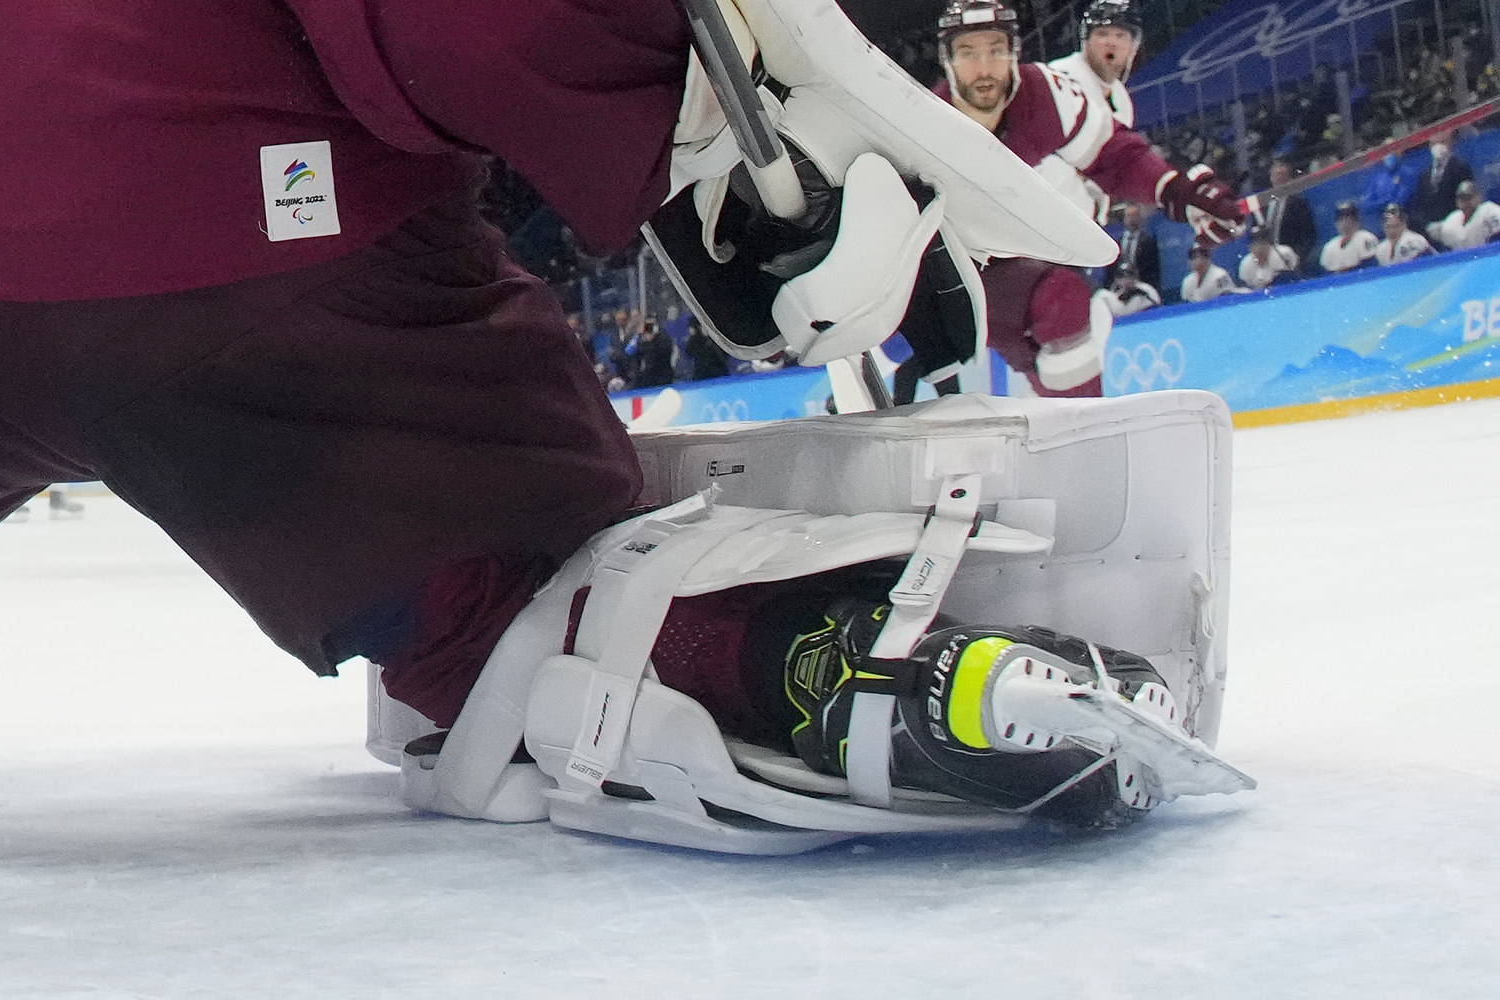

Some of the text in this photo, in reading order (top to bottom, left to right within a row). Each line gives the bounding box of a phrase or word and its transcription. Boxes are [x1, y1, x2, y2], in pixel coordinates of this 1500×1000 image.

[275, 195, 325, 208] BEIJING 2022
[927, 633, 968, 742] BAUER
